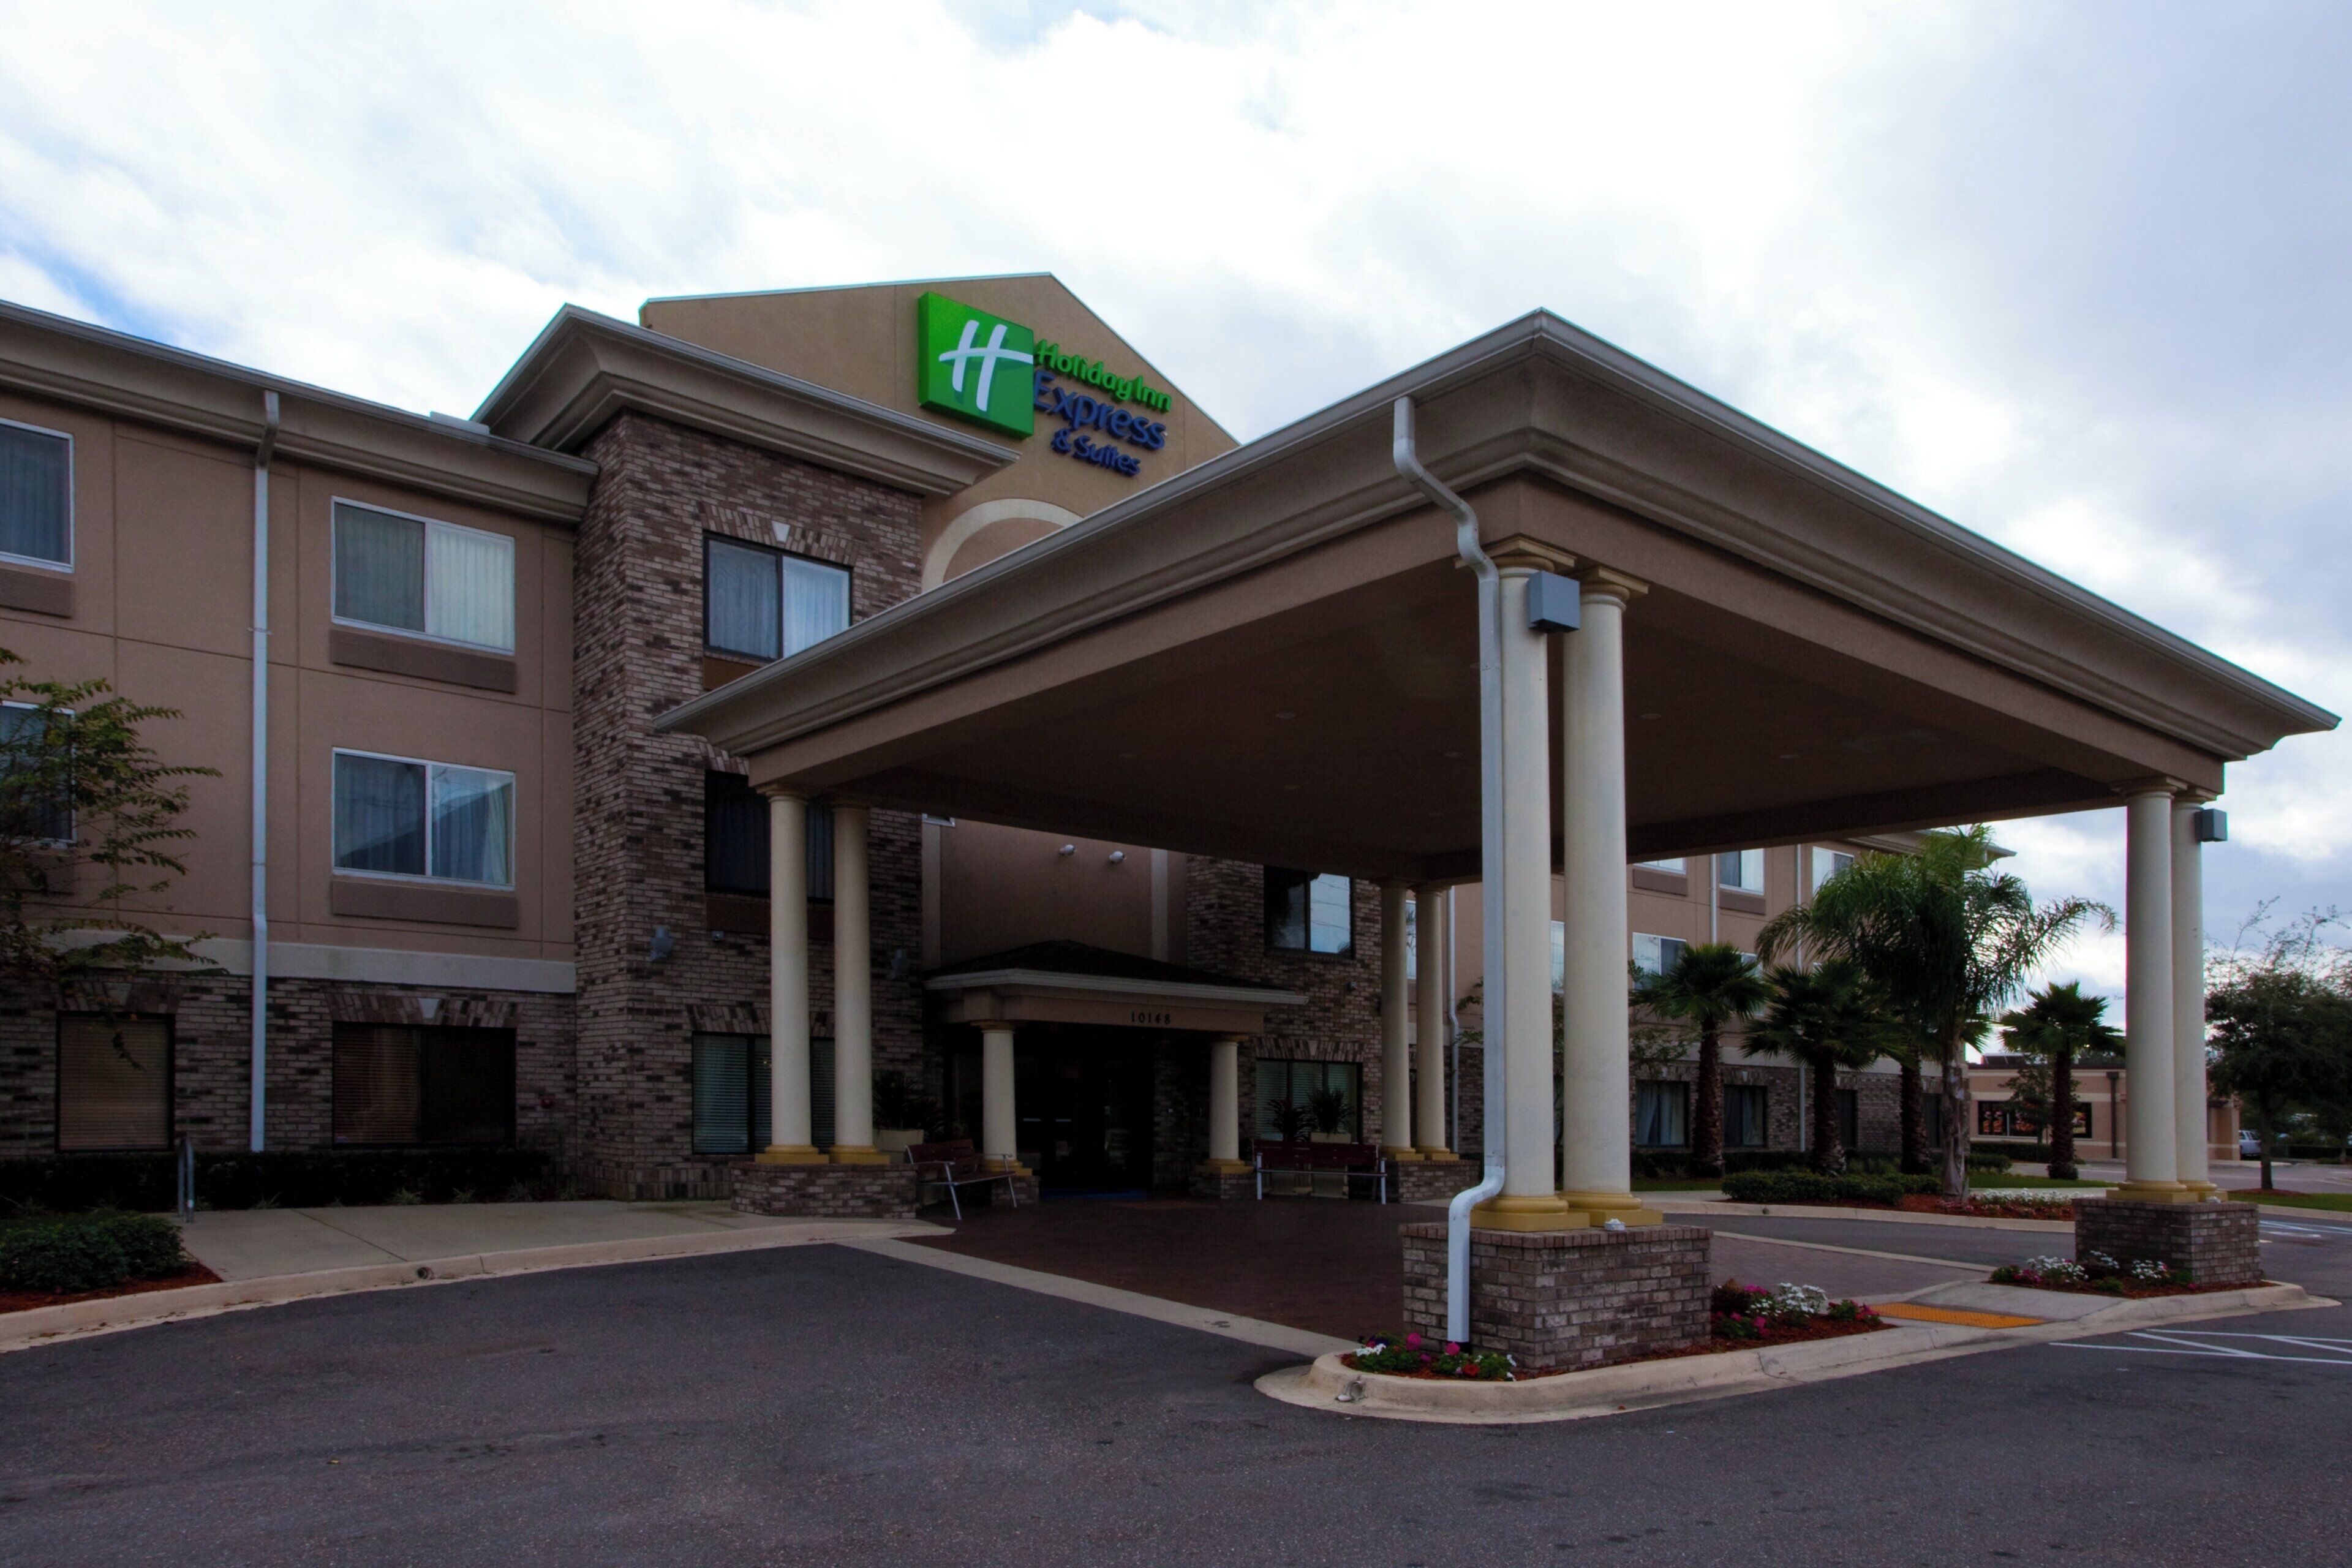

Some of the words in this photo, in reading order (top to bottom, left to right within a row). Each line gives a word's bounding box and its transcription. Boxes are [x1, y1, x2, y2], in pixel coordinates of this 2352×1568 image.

[1035, 339, 1133, 402] Holiday
[1133, 375, 1172, 413] Inn
[1034, 369, 1166, 450] Express
[1051, 429, 1071, 454] &
[1073, 435, 1140, 477] Suites
[1131, 1011, 1170, 1025] 10148
